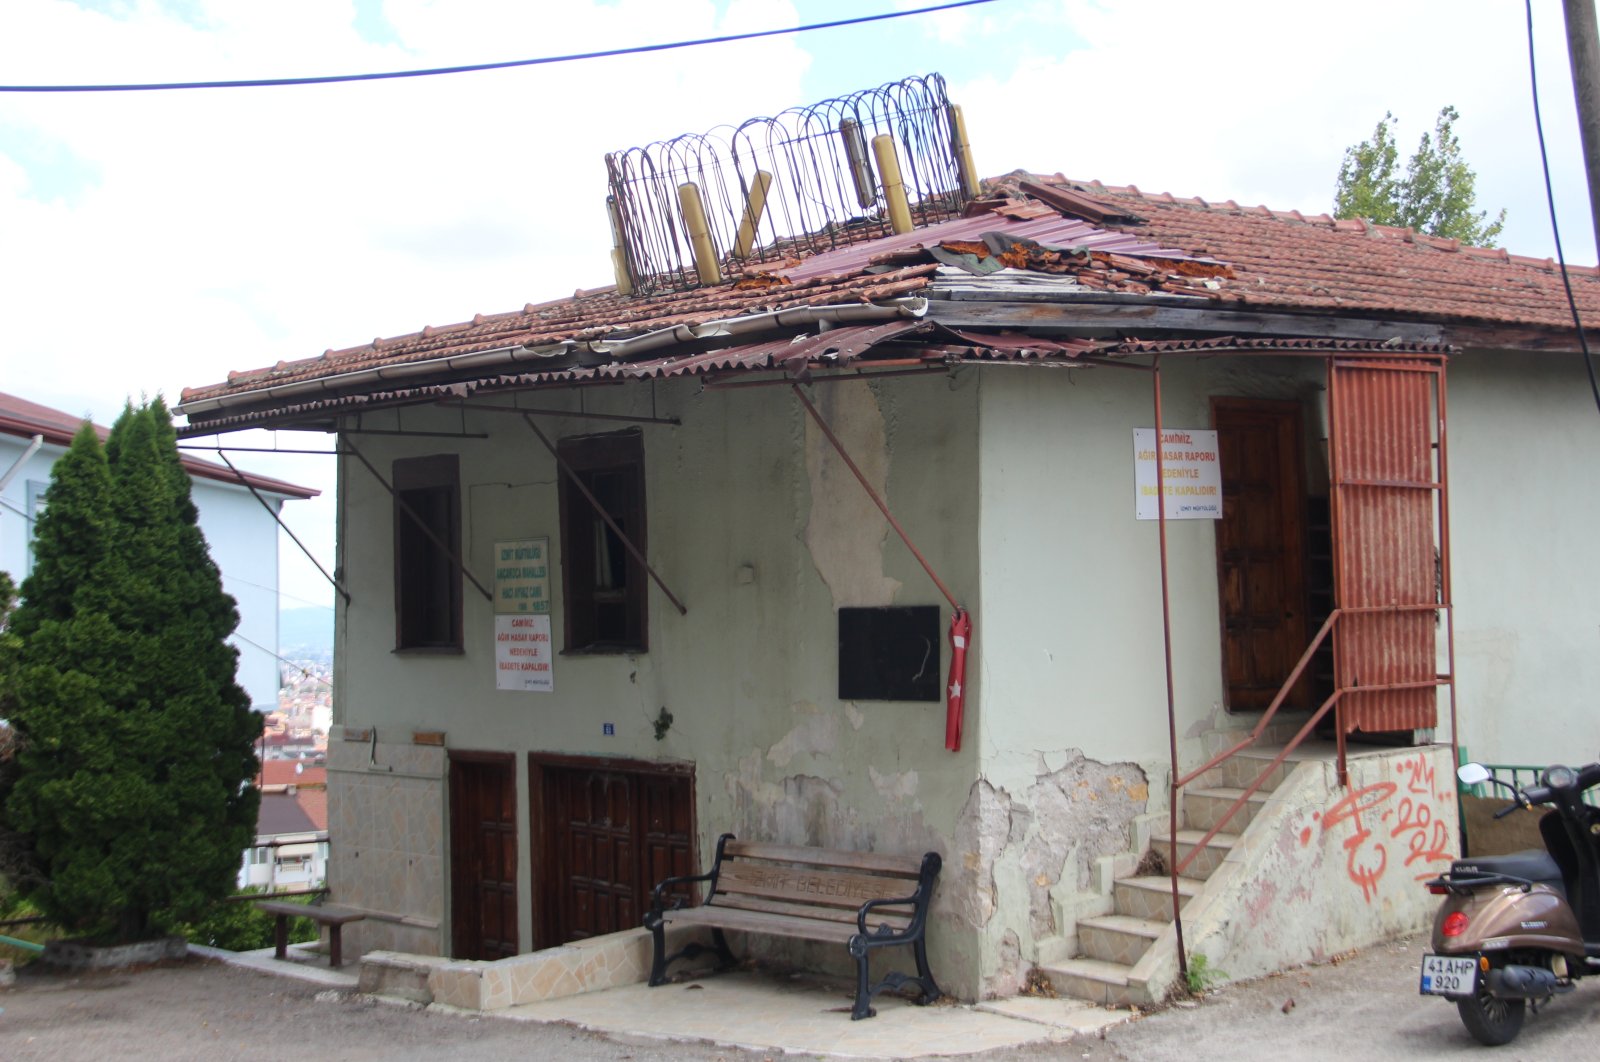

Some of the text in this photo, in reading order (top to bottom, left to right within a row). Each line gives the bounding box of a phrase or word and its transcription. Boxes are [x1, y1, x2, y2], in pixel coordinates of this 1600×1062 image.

[1162, 451, 1183, 461] ASAR
[1185, 451, 1216, 462] RAPORU
[1162, 467, 1200, 479] EDENİYLE
[1435, 975, 1460, 990] 920
